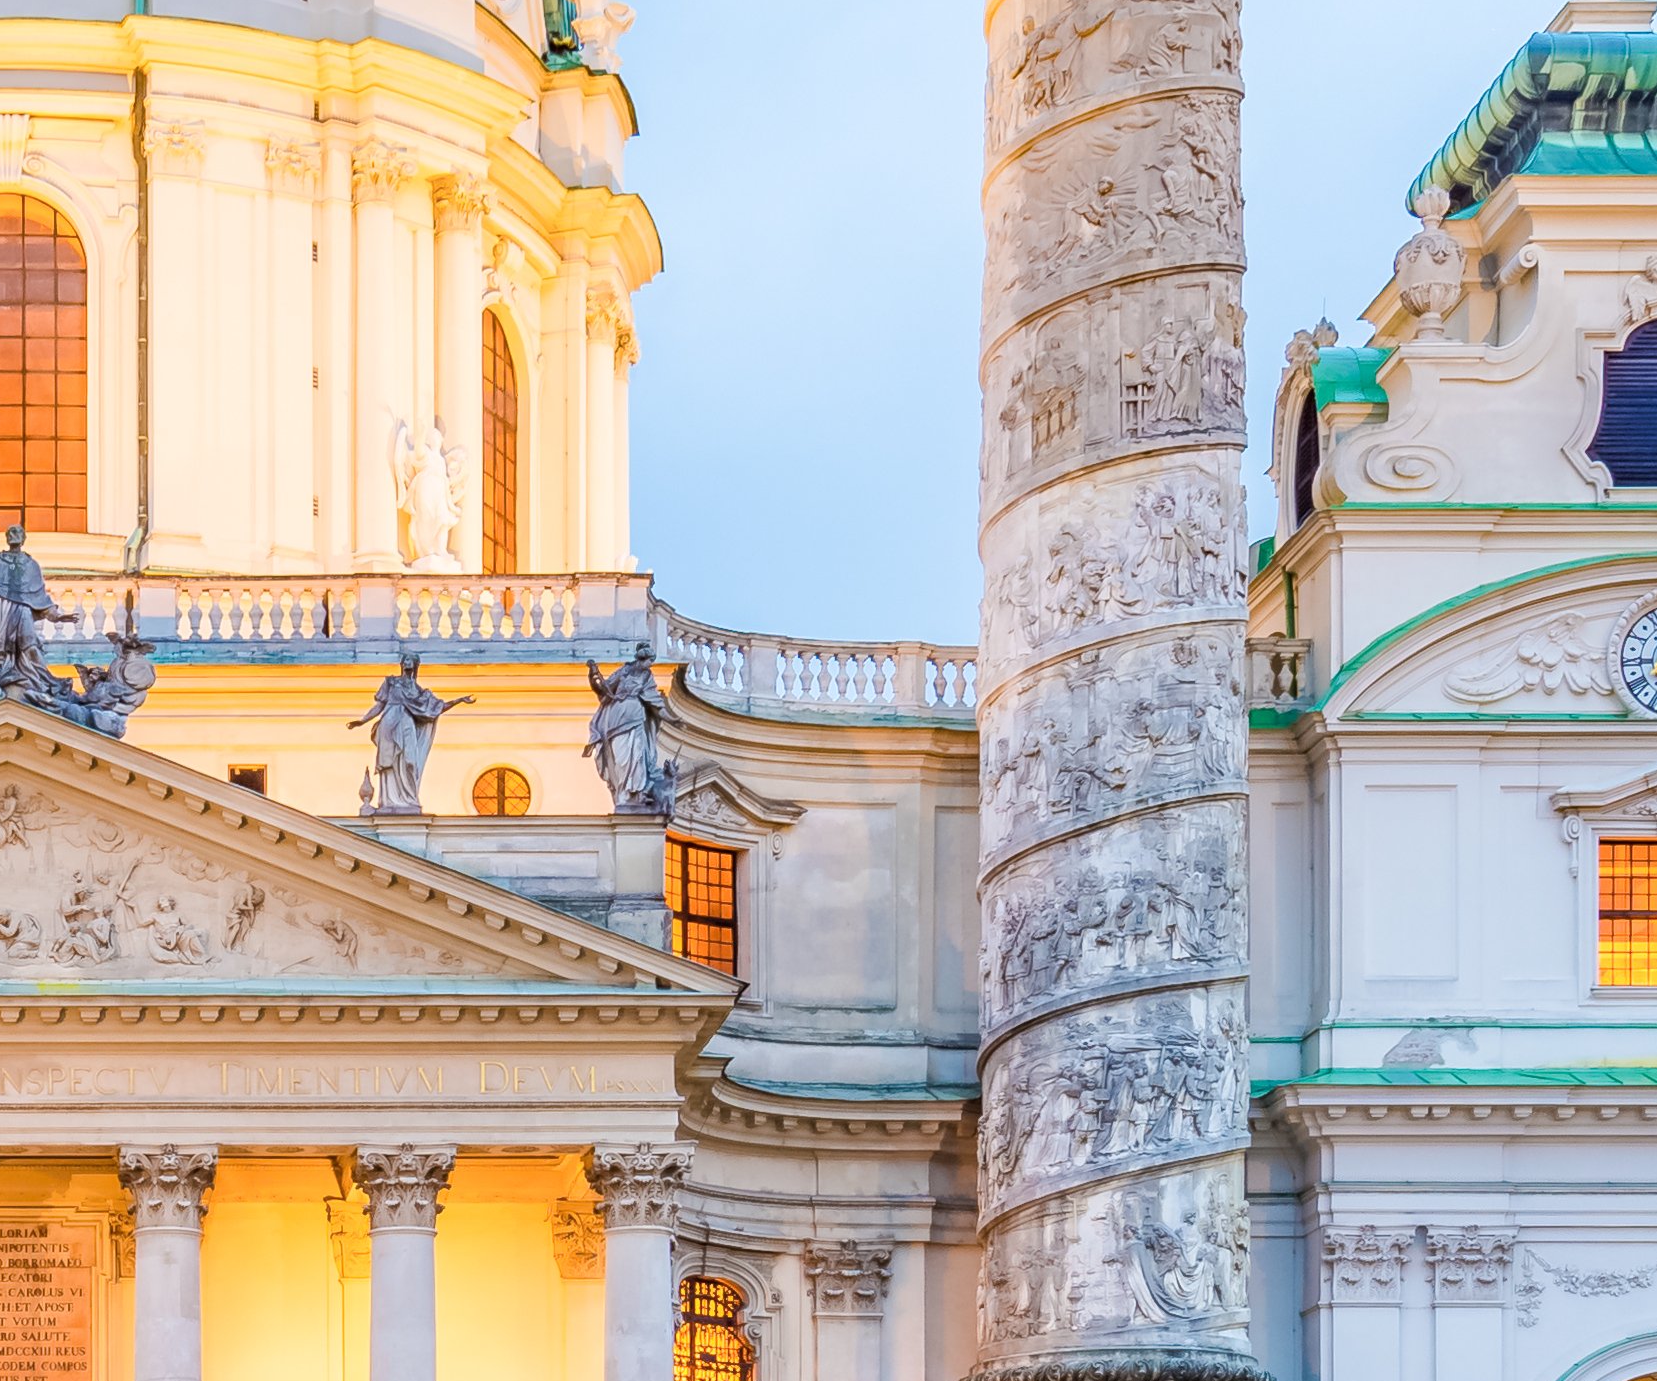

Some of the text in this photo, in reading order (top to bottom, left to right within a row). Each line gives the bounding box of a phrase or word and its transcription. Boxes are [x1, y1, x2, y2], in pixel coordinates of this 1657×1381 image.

[209, 1061, 444, 1095] TIMENTIVM
[8, 1258, 82, 1268] BORROMAEO
[8, 1287, 64, 1297] CAROLUS
[12, 1317, 57, 1327] VOTUM
[21, 1331, 71, 1341] SALUTE
[55, 1346, 86, 1357] REUS
[41, 1361, 88, 1371] COMPOS
